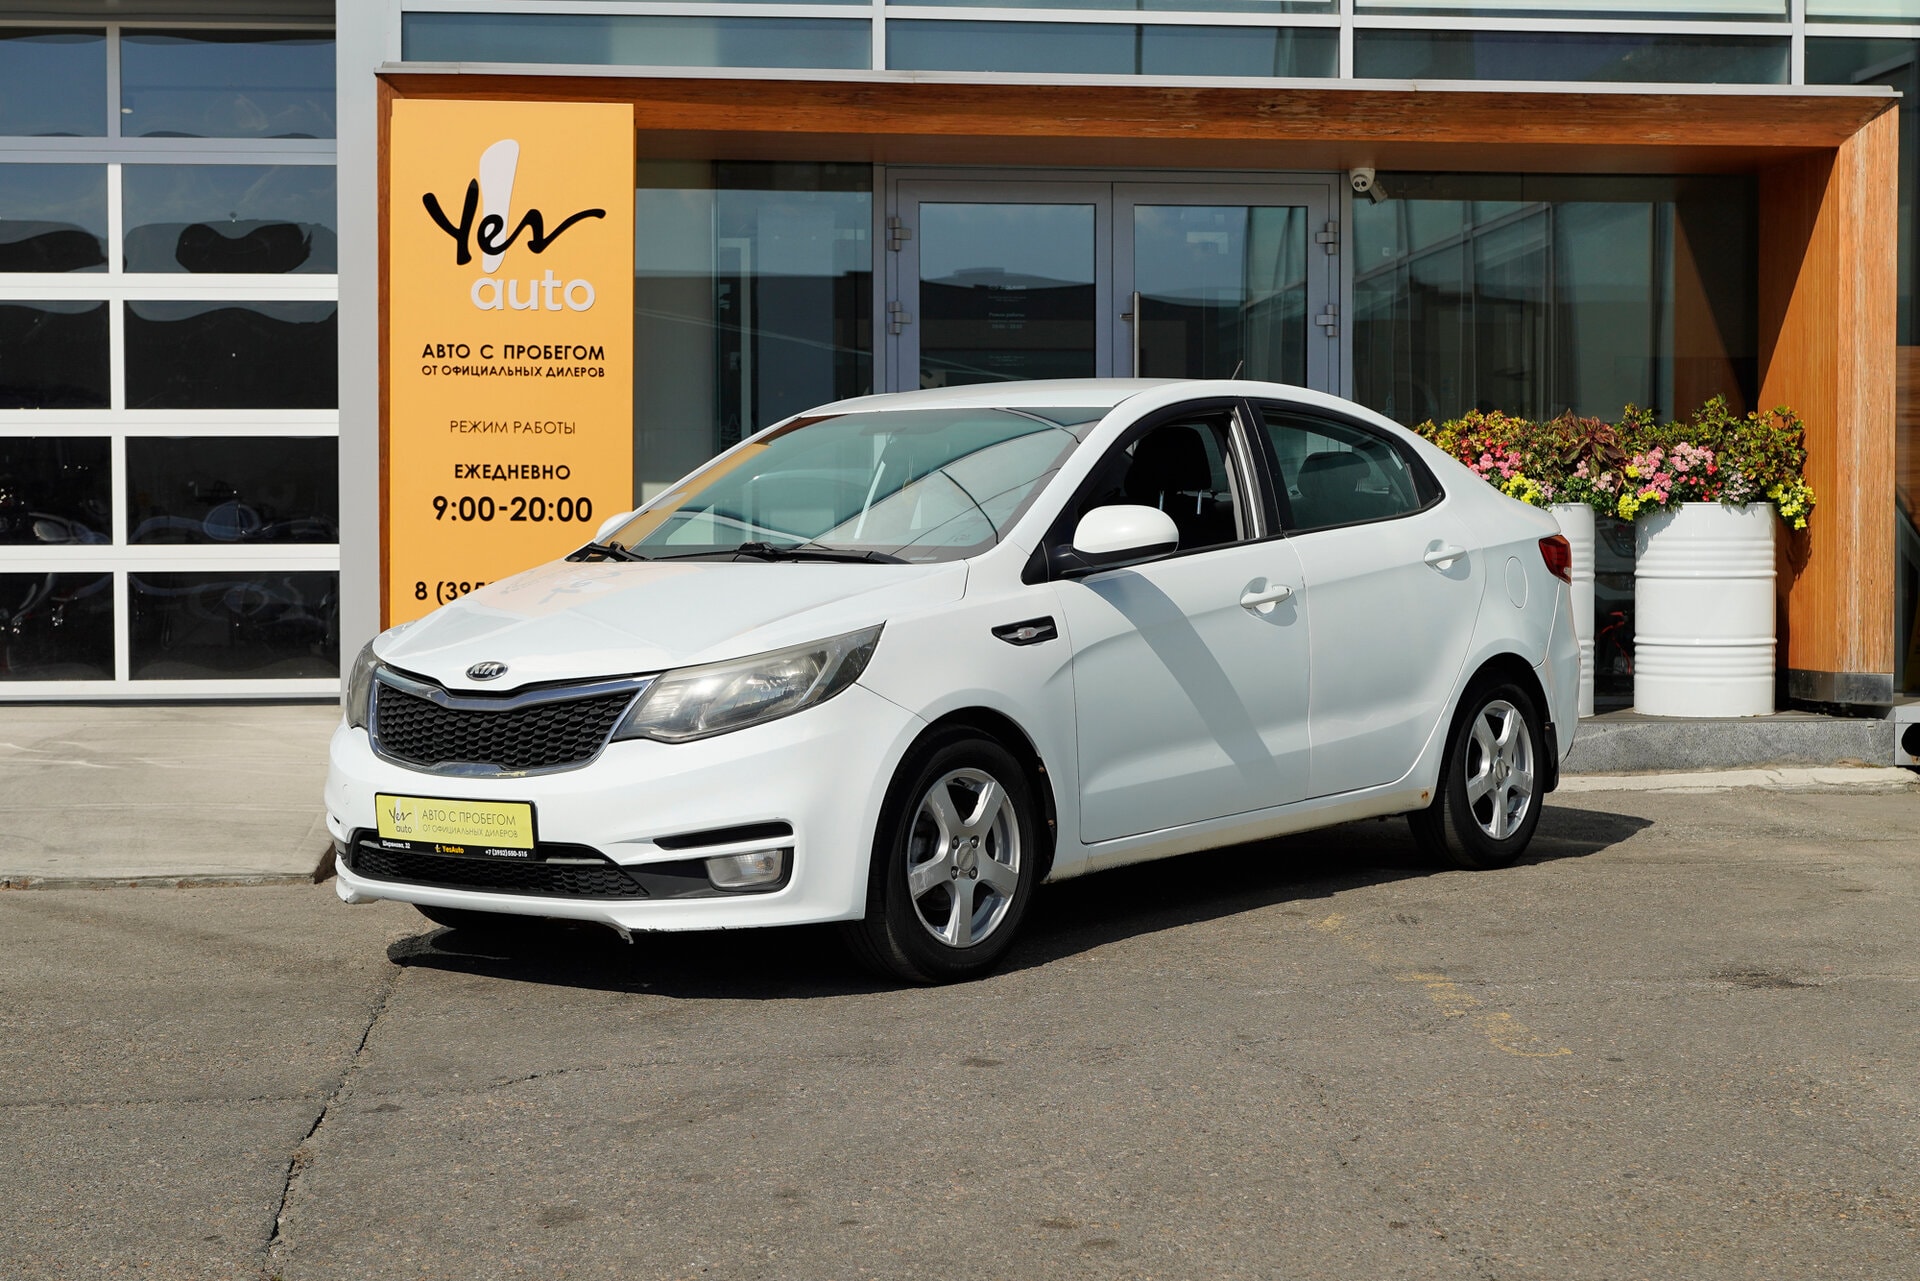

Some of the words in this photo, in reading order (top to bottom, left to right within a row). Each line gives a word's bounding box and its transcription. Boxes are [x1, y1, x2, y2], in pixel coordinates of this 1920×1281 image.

[422, 178, 606, 265] Yes
[470, 270, 596, 311] auto
[422, 344, 471, 359] АВТО
[480, 345, 494, 359] С
[503, 345, 605, 361] ПРОБЕГОМ
[421, 365, 438, 376] ОТ
[442, 365, 543, 378] ОФИЦИАЛЬНЫХ
[546, 367, 605, 379] ДИЛЕРОВ
[450, 420, 509, 434] РЕЖИМ
[514, 421, 576, 435] РАБОТЫ
[454, 464, 571, 481] ЕЖЕДНЕВНО
[432, 495, 593, 522] 9:00-20:00
[415, 581, 428, 600] 8
[422, 809, 447, 822] АВТО
[448, 811, 457, 823] С
[459, 812, 516, 826] ПРОБЕГОМ
[396, 825, 413, 834] auto
[432, 826, 483, 837] ОФИЦИАЛЬНЫХ
[484, 829, 518, 838] ДИЛЕРОВ
